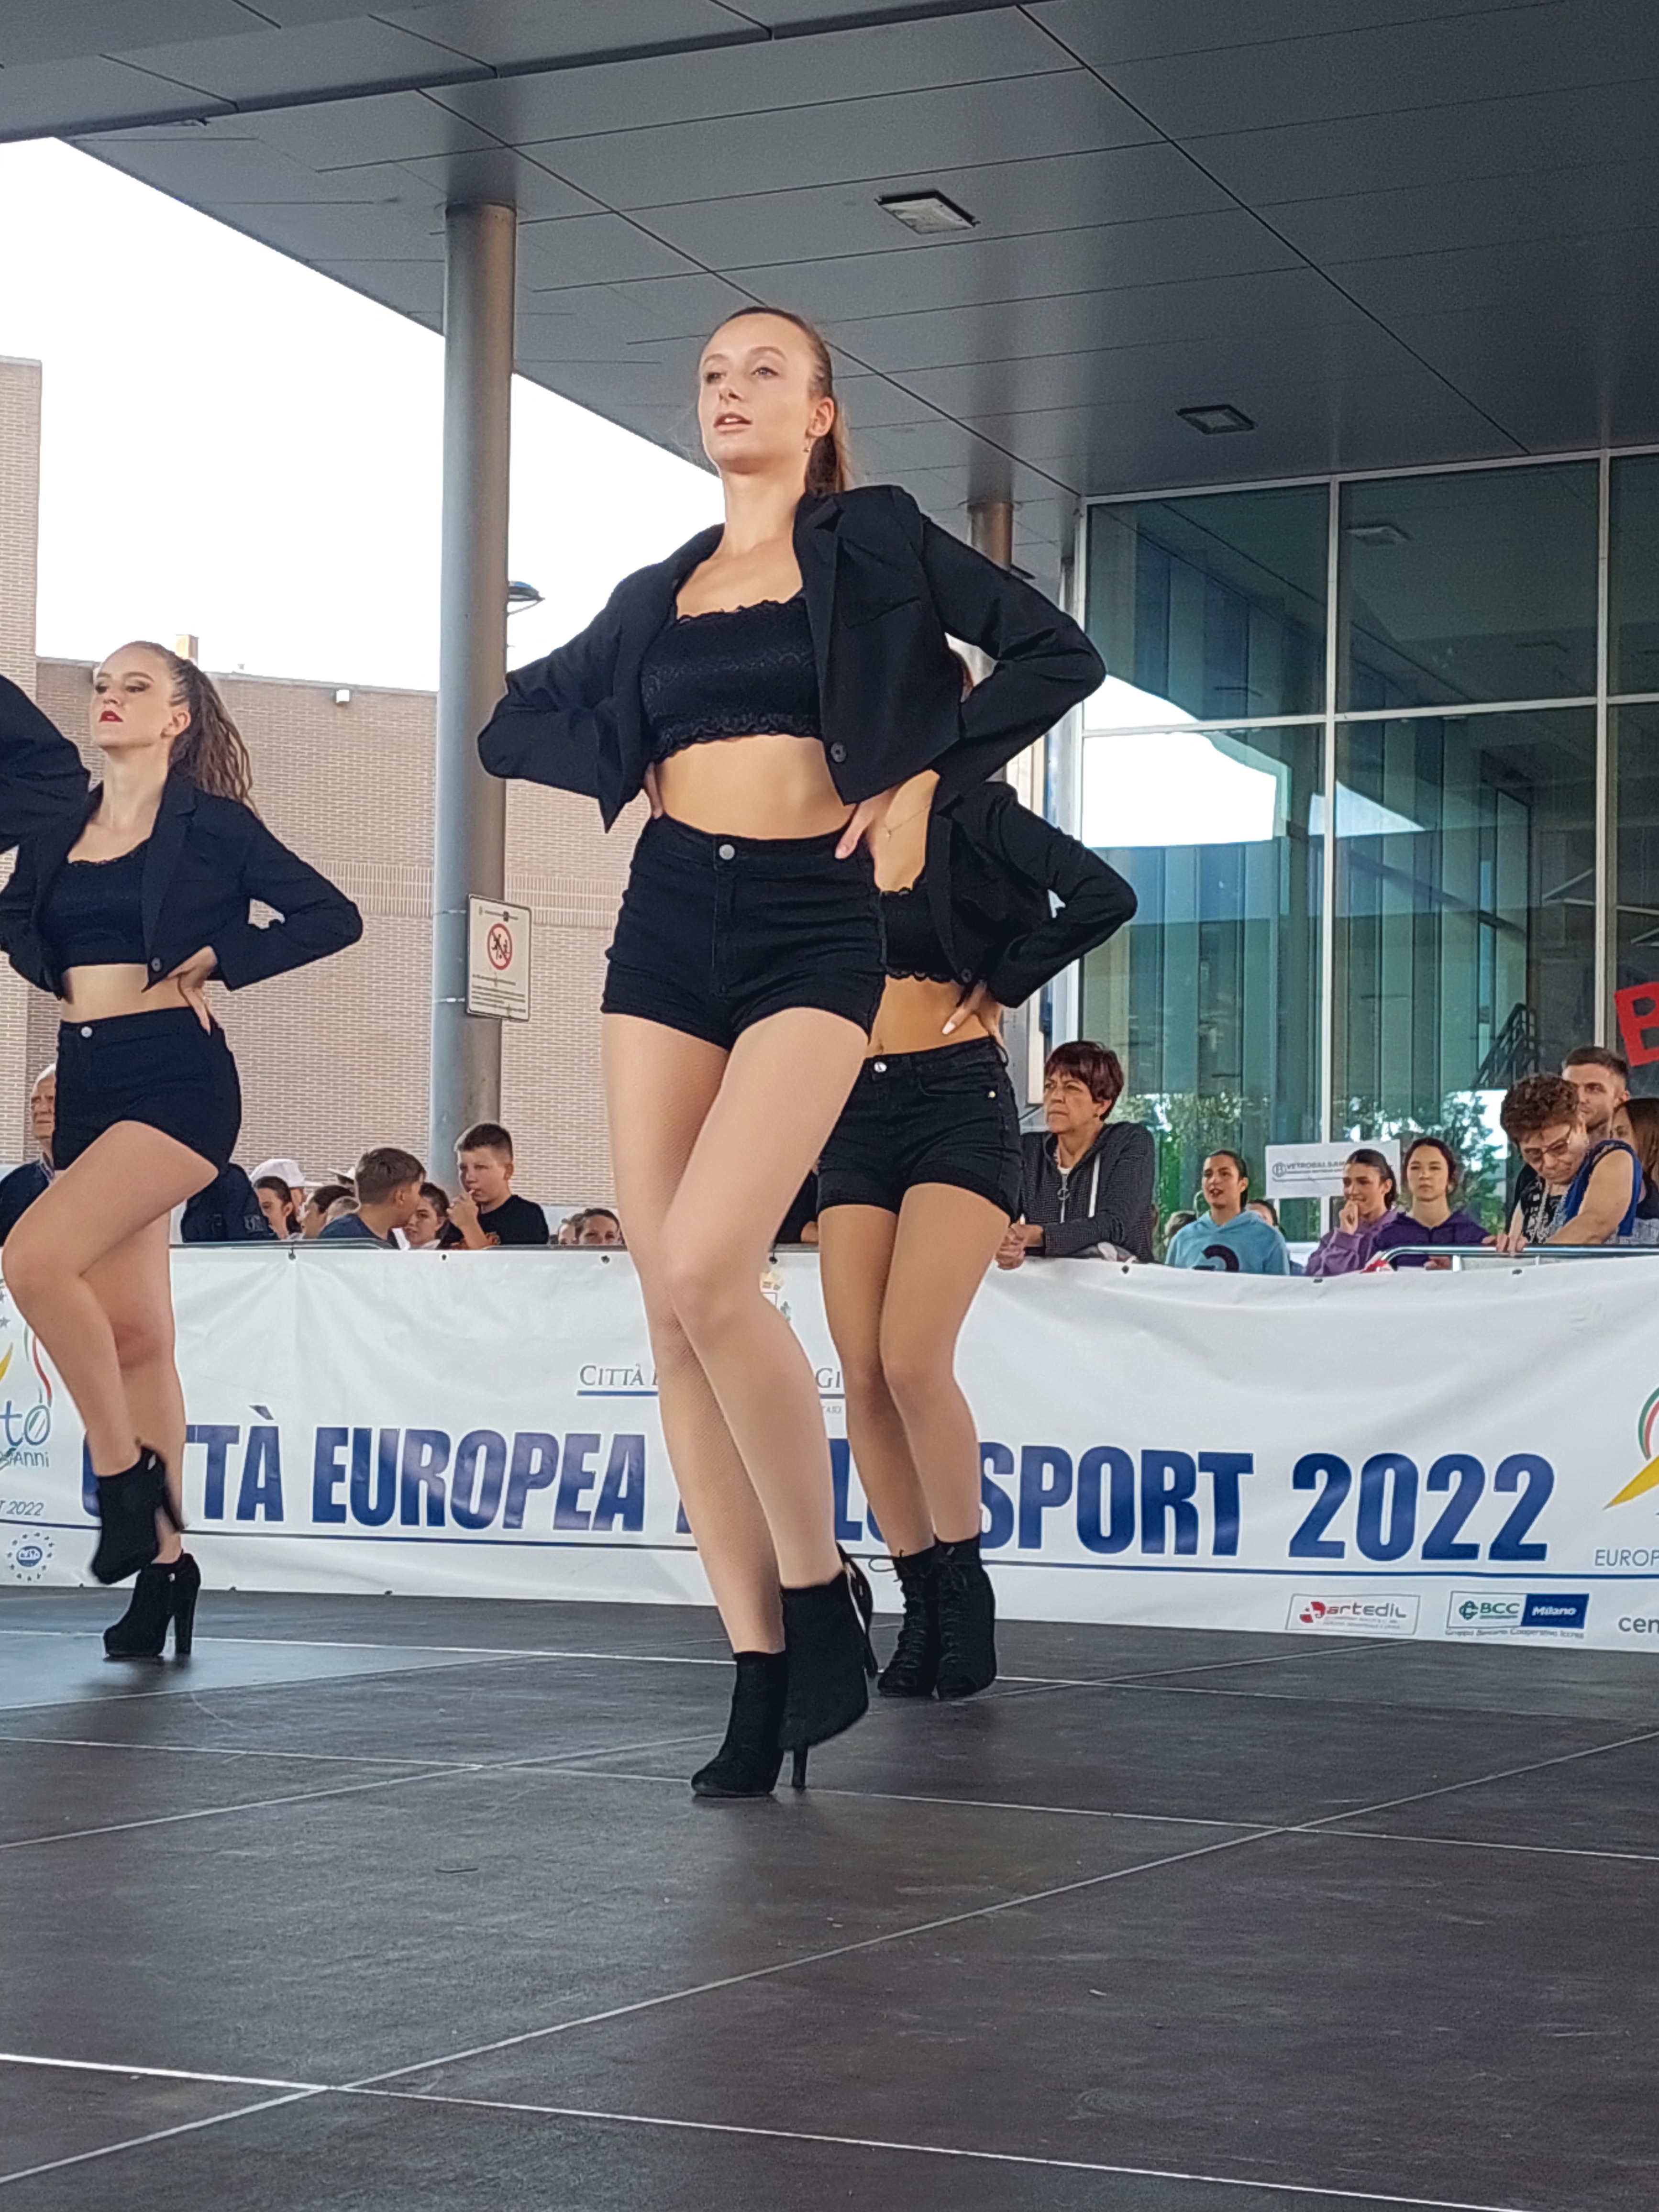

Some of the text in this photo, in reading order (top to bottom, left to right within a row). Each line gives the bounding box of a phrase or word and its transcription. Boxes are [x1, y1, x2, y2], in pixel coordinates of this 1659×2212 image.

[579, 1363, 645, 1386] CITTÀ
[312, 1427, 645, 1532] EUROPEA
[979, 1441, 1254, 1556] SPORT
[1288, 1452, 1555, 1561] 2022
[6, 1500, 44, 1516] 2022
[1480, 1603, 1577, 1616] BCC Milano
